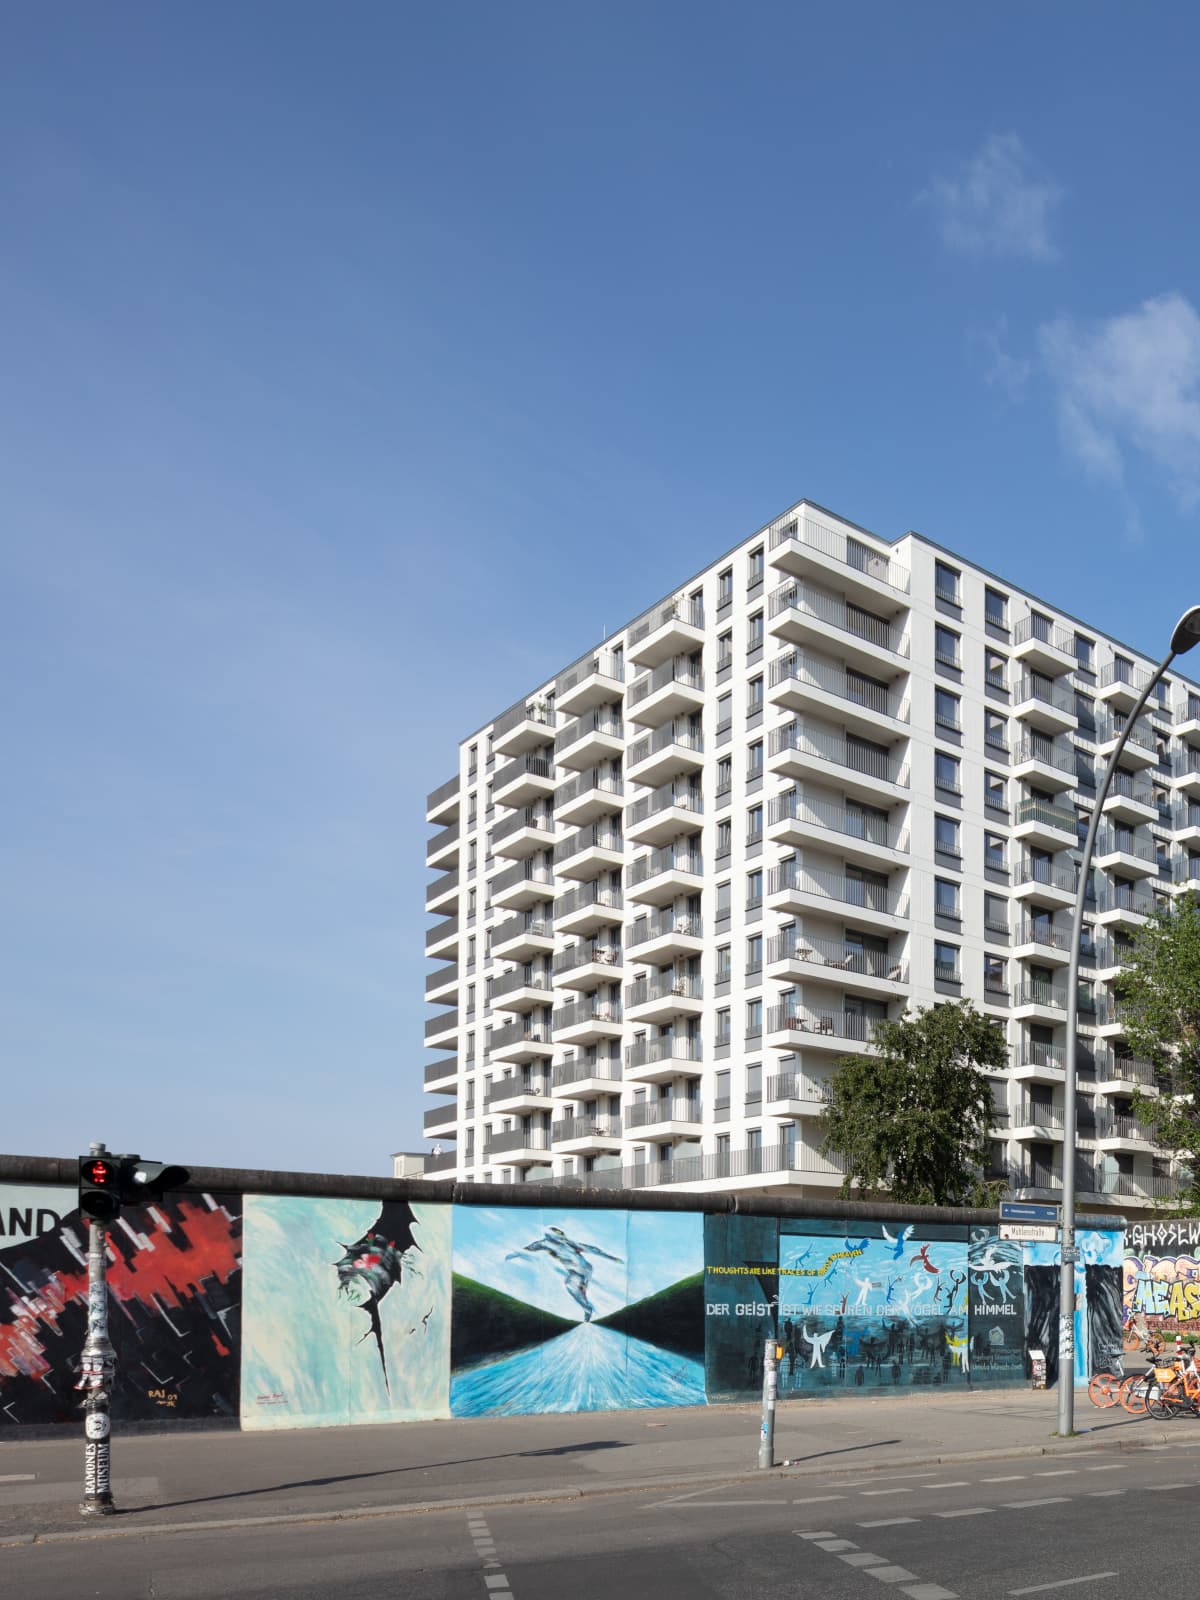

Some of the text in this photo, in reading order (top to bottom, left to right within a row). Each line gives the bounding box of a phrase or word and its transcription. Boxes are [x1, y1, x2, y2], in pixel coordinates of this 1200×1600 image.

[706, 1303, 730, 1316] DER
[779, 1303, 798, 1316] IST
[803, 1304, 822, 1316] WIE
[974, 1304, 1017, 1316] HIMMEL
[85, 1443, 96, 1494] RAMONES
[97, 1443, 109, 1493] MUSEUM
